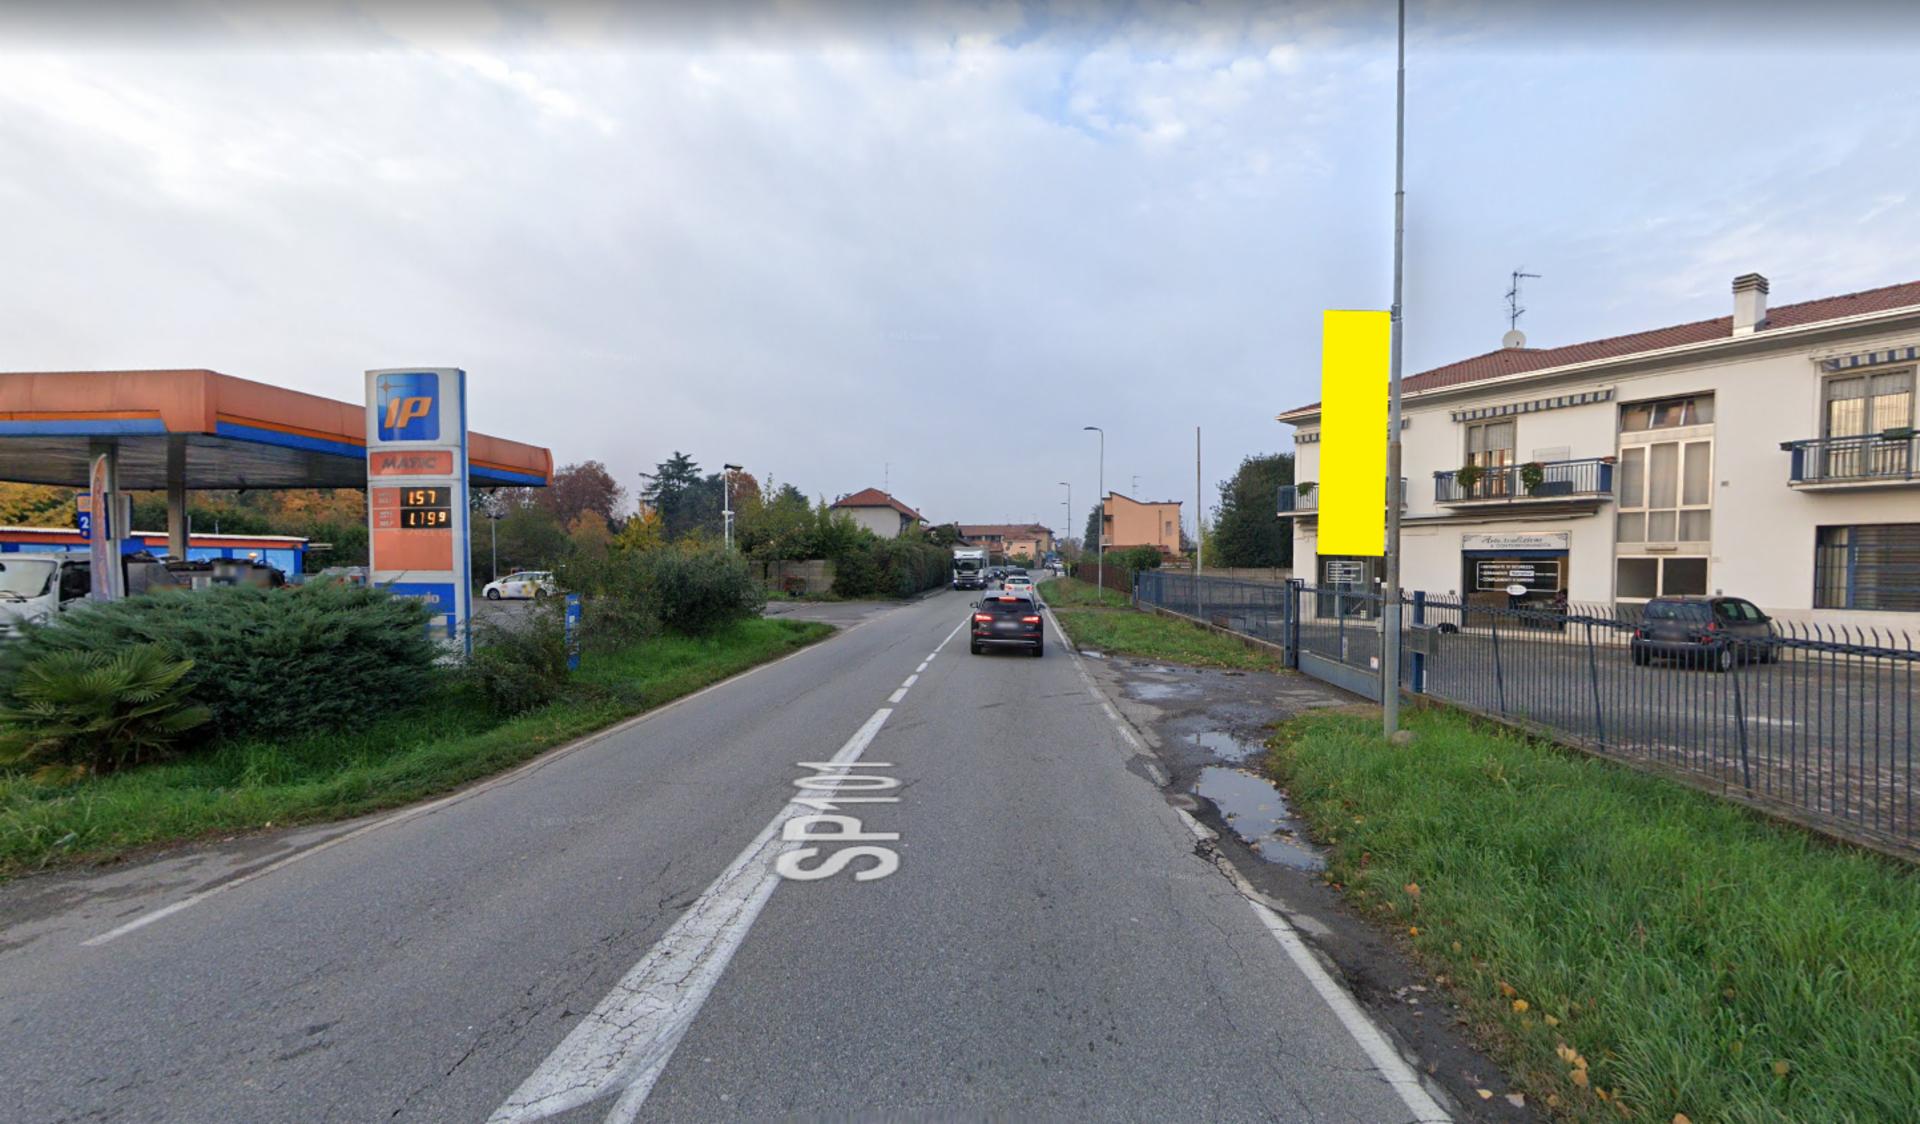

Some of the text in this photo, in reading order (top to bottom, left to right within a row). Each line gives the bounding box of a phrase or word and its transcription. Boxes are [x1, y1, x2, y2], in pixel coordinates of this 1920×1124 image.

[384, 397, 432, 428] IP
[382, 457, 434, 469] MATIC
[80, 517, 89, 528] 2
